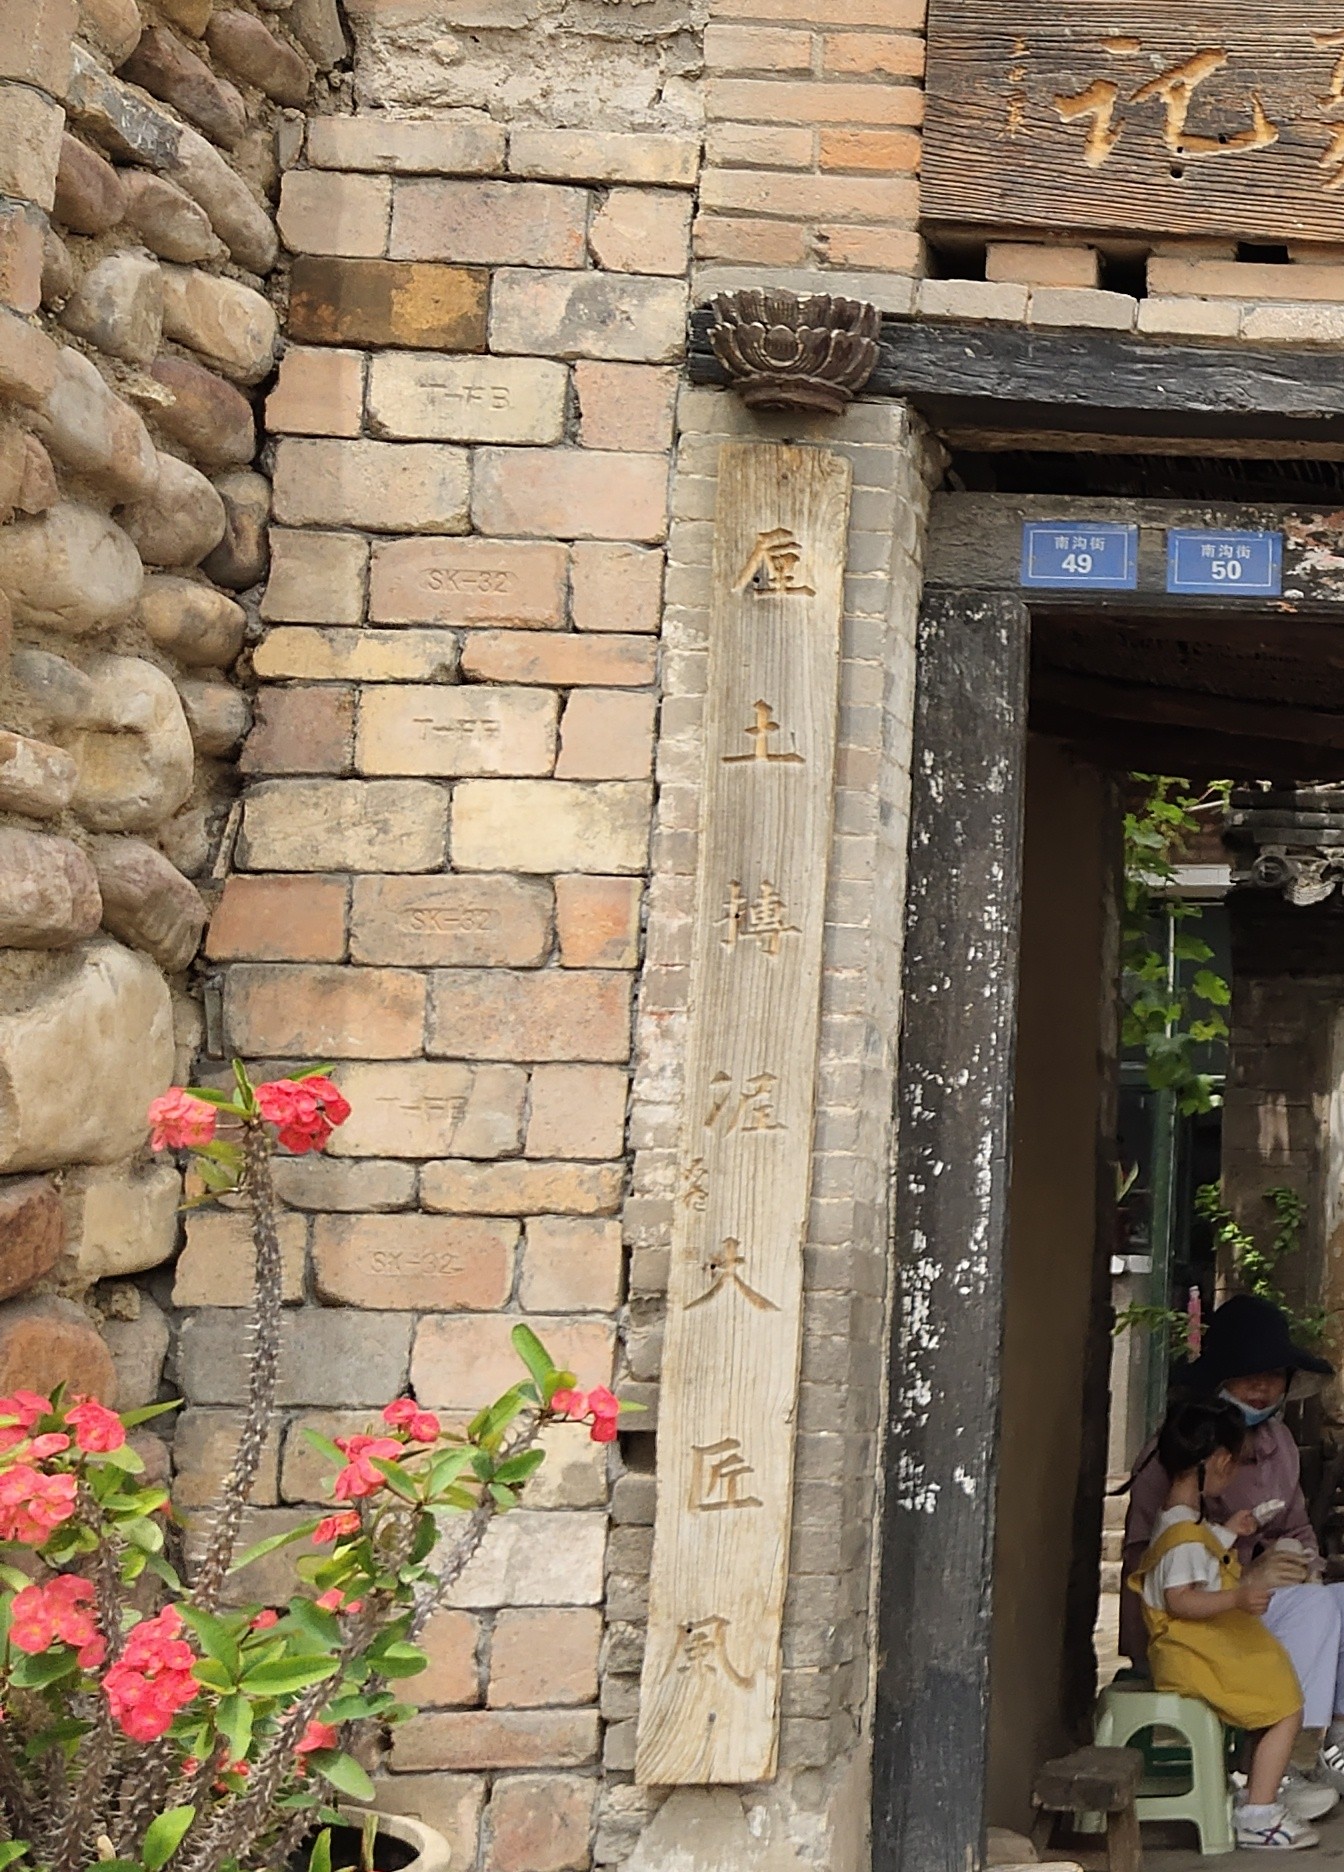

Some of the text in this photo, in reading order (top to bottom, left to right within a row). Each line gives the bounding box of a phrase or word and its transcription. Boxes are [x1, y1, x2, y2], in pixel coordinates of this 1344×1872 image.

[1054, 535, 1106, 551] 南沟街
[1201, 543, 1252, 559] 南沟街
[1061, 553, 1093, 574] 49
[1211, 560, 1242, 580] 50
[427, 568, 509, 593] SK-32
